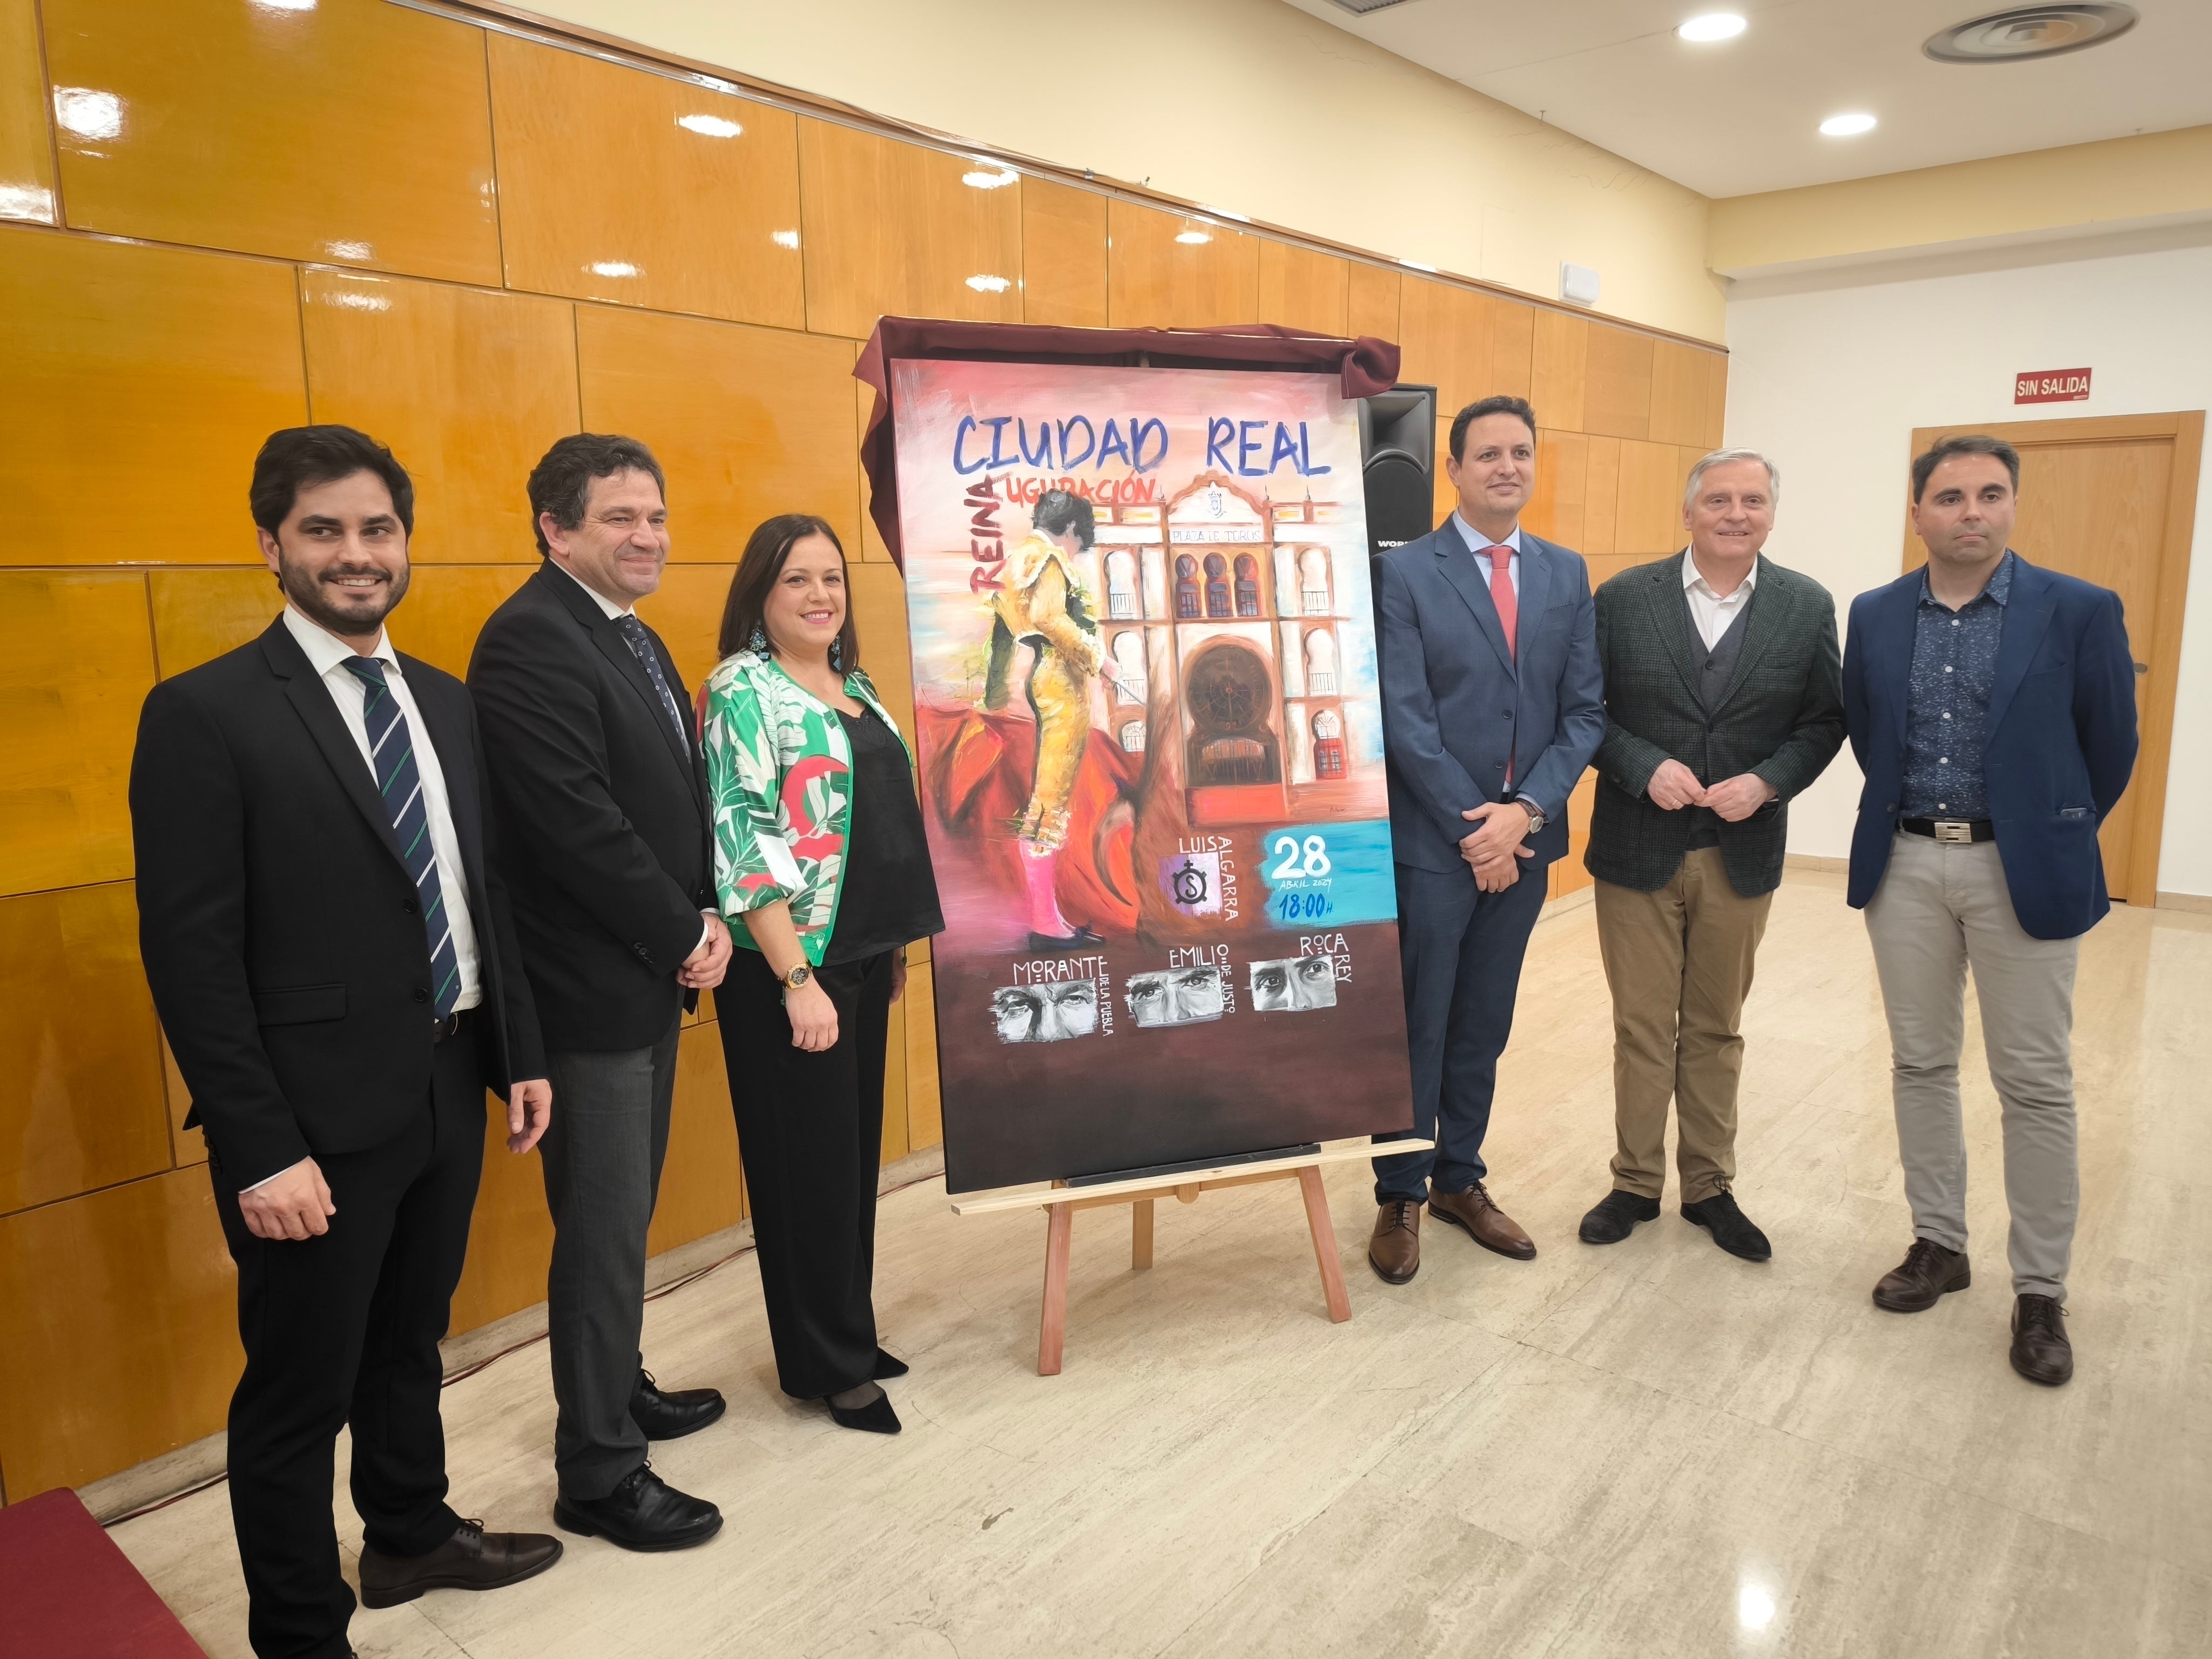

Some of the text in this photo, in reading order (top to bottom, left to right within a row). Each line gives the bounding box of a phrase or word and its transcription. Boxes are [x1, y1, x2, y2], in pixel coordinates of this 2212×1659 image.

[2017, 376, 2088, 396] SIN SALIDA
[954, 415, 1332, 477] CIUDAD REAL
[963, 474, 1007, 595] REINA
[1172, 530, 1260, 542] PLAZA DE TOROS
[1179, 836, 1217, 853] LUIS
[1271, 835, 1331, 879] 28
[1218, 836, 1239, 921] ALGARRA
[1278, 878, 1332, 893] ABRIL 2024
[1170, 945, 1229, 968] EMILIO
[1300, 933, 1349, 956] ROCA
[1013, 956, 1107, 984] MORANTE
[1334, 955, 1352, 982] REY
[1221, 965, 1235, 1013] DE JUSTO
[1099, 977, 1114, 1037] DE LA PUEBLA
